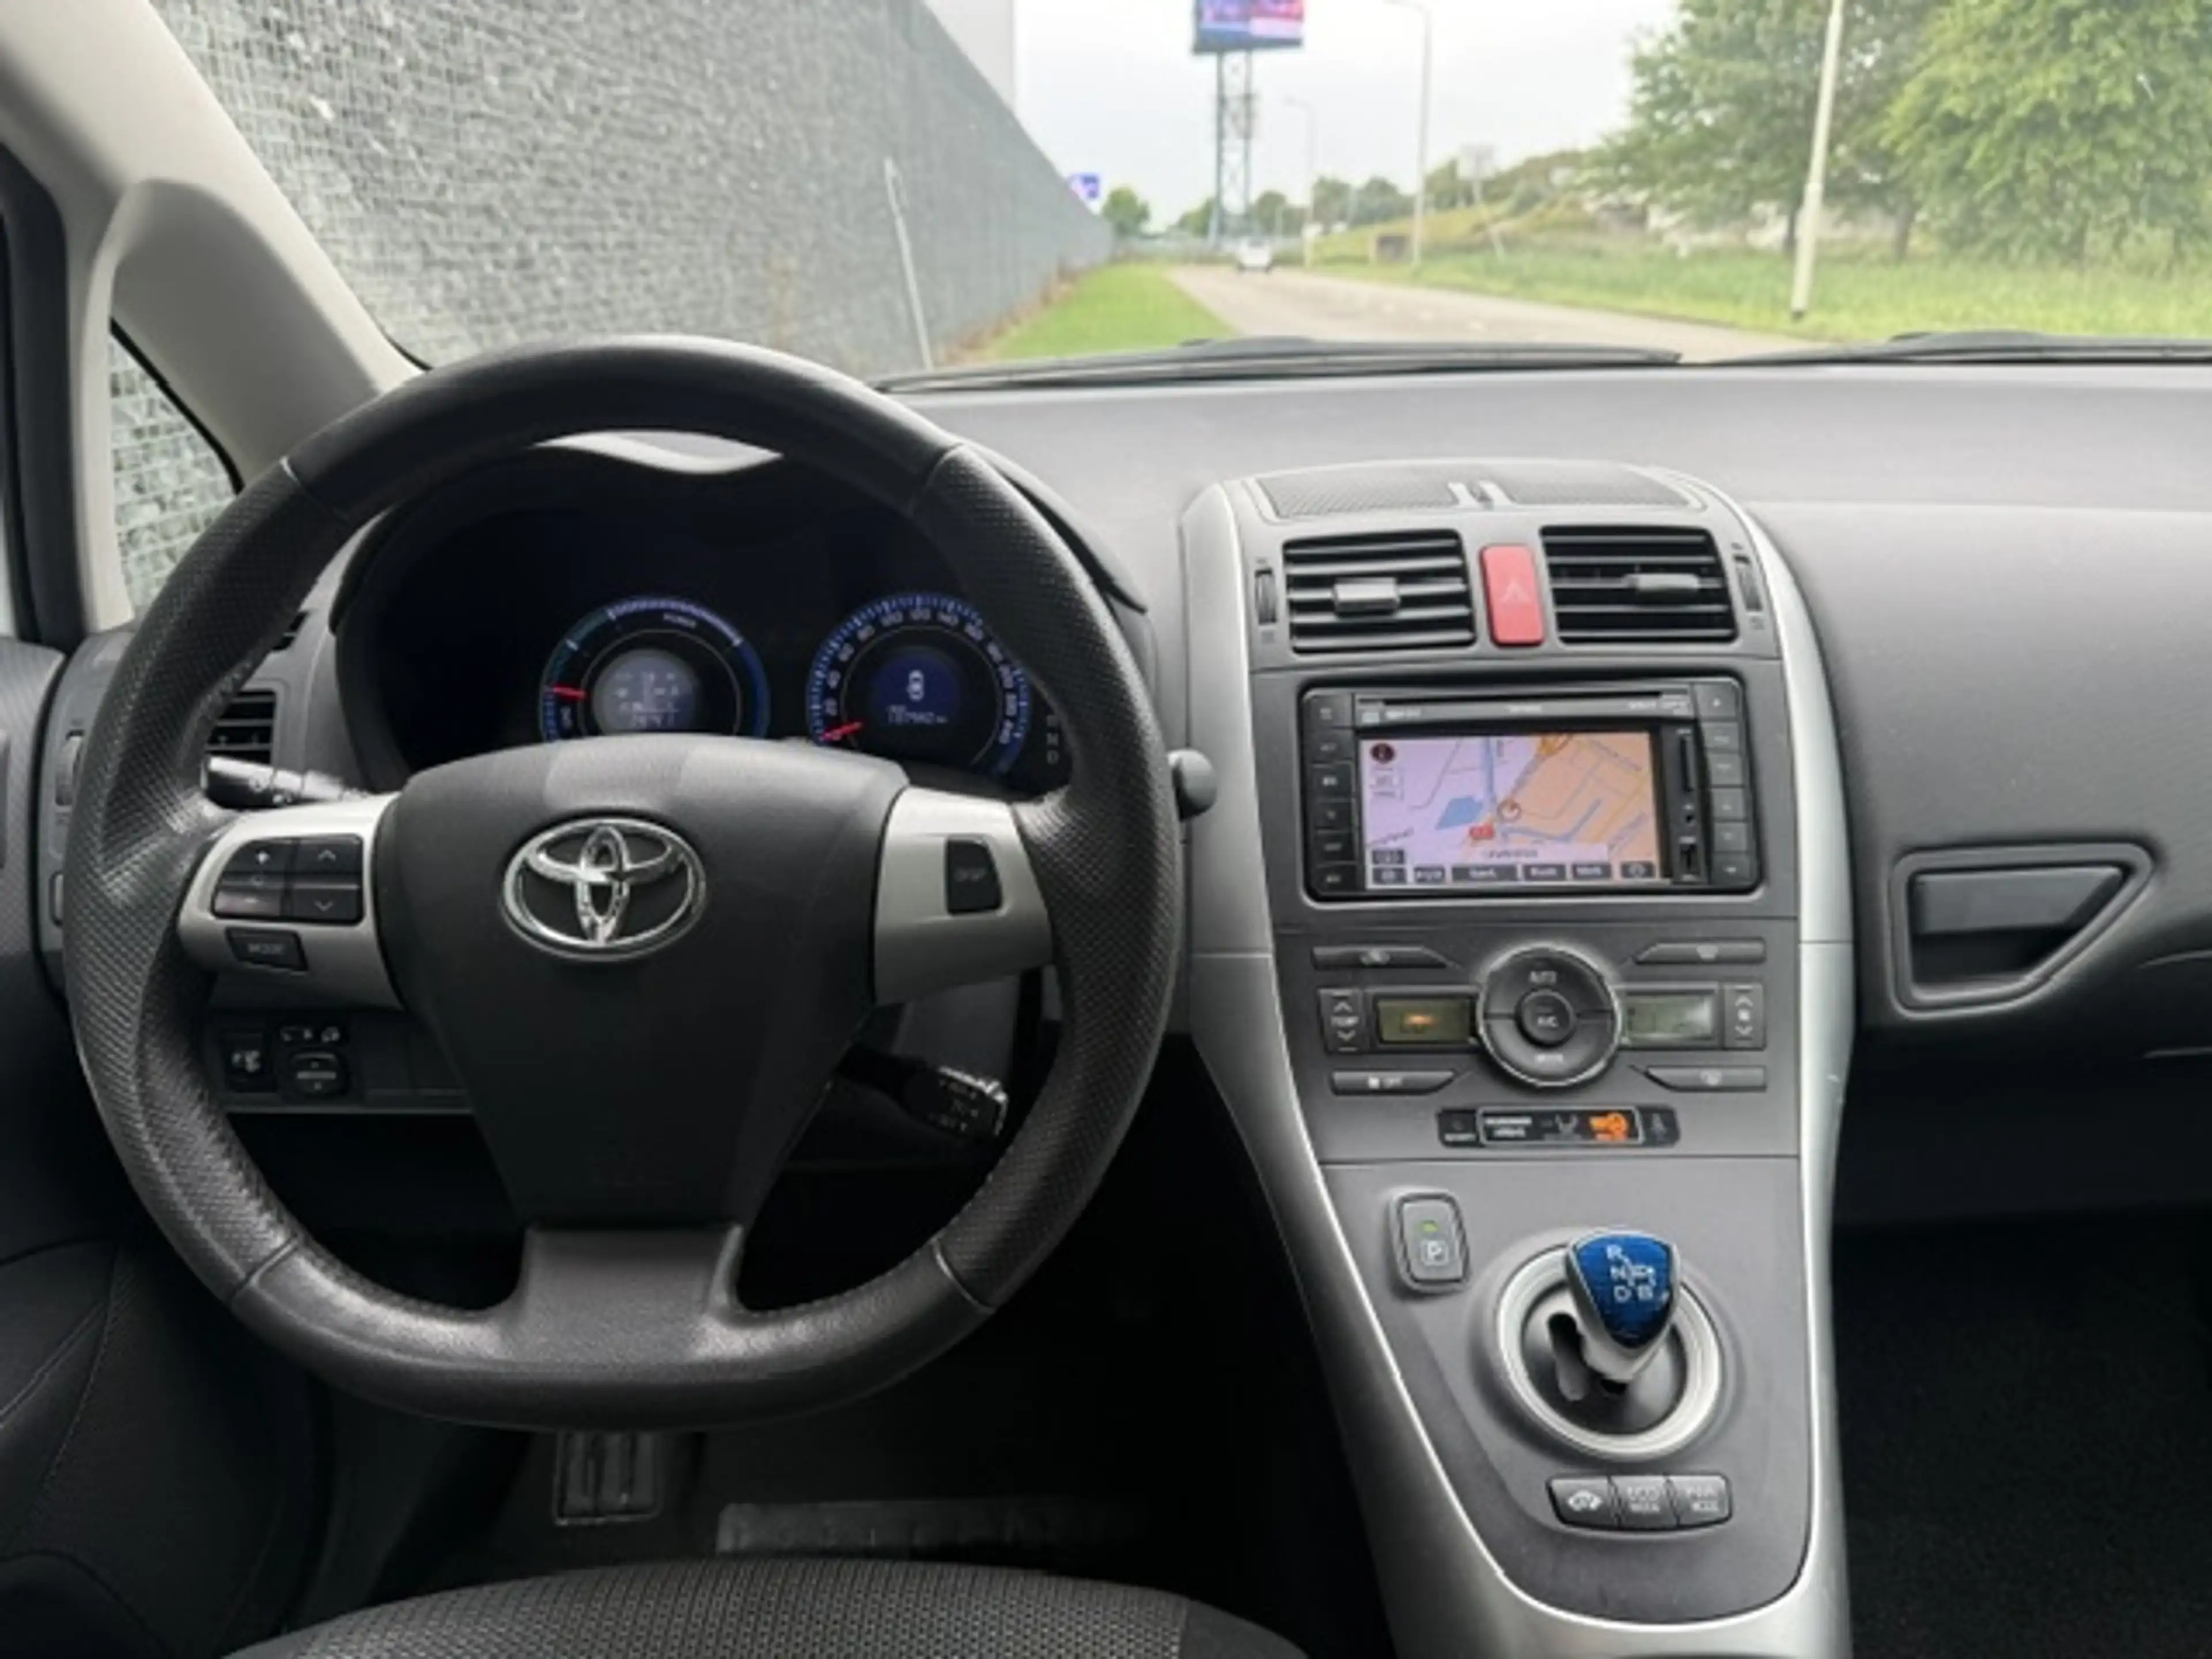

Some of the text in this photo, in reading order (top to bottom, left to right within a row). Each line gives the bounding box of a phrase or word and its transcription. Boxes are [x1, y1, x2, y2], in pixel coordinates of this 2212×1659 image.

[1427, 1240, 1443, 1259] P
[1607, 1244, 1622, 1260] R
[1613, 1285, 1632, 1303] D
[1637, 1285, 1653, 1301] B
